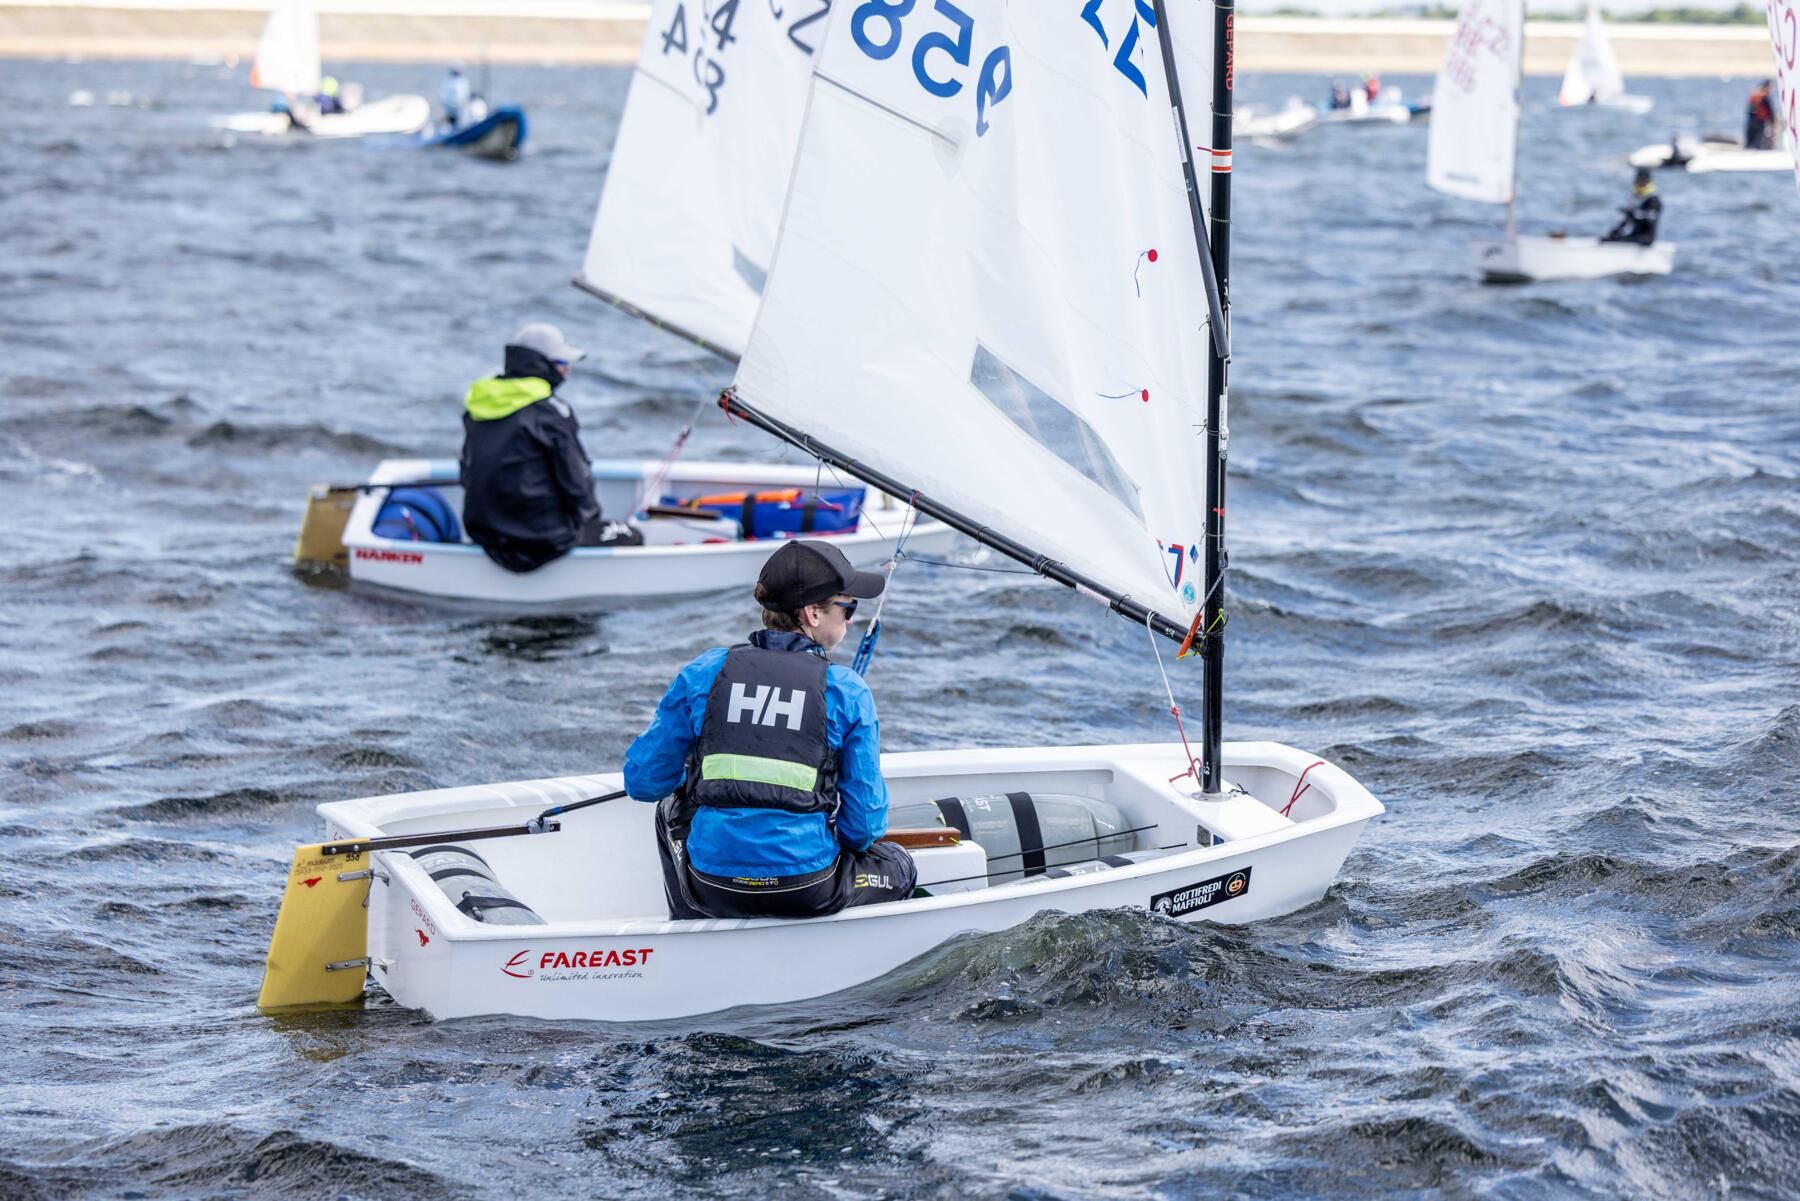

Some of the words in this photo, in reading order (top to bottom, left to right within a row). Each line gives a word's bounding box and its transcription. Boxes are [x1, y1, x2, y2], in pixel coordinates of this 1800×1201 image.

[1225, 13, 1235, 92] GEPARD
[726, 682, 807, 731] HH
[867, 873, 894, 890] GUL
[1173, 880, 1222, 904] GOTTIFREDI
[410, 898, 436, 936] GEPARD
[539, 948, 654, 969] FAREAST
[539, 972, 588, 982] unlimited
[592, 969, 644, 981] innovation
